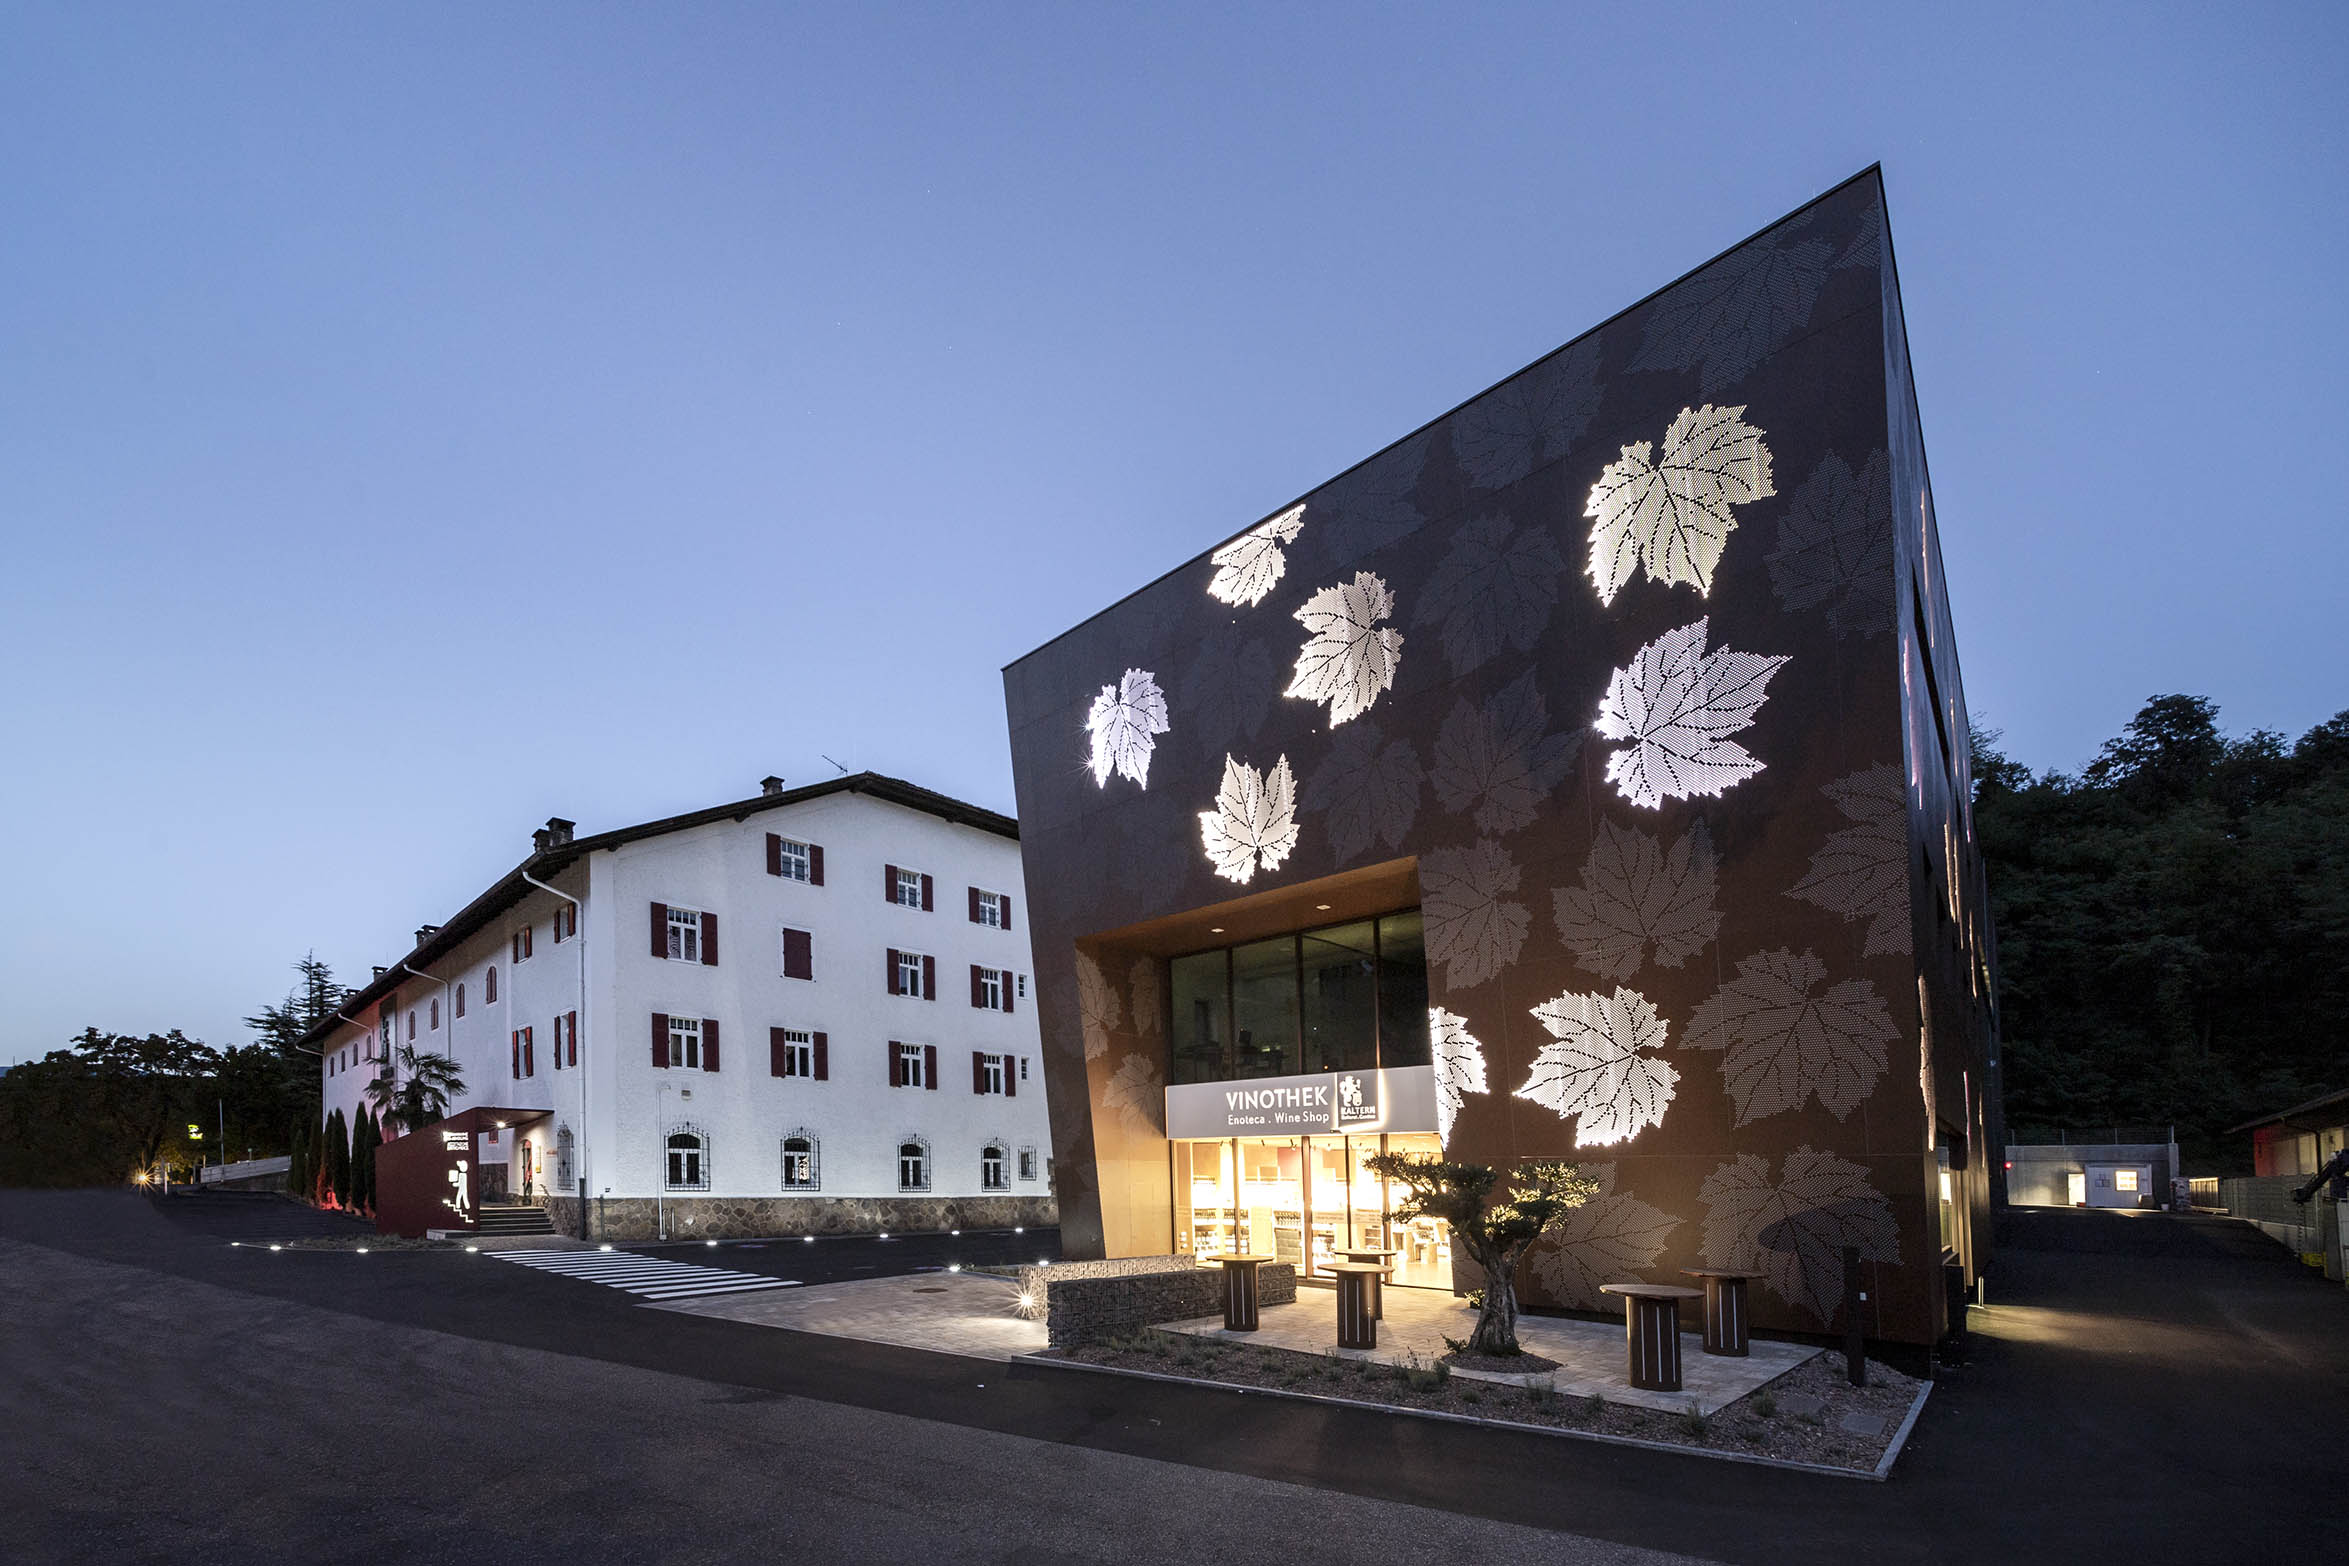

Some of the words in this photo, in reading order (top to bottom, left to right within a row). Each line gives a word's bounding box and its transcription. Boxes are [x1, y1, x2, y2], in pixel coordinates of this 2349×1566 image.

[1225, 1085, 1329, 1112] VINOTHEK
[1228, 1114, 1265, 1126] Enoteca
[1274, 1111, 1301, 1124] Wine
[1303, 1110, 1330, 1124] Shop
[1340, 1105, 1376, 1115] KALTERN
